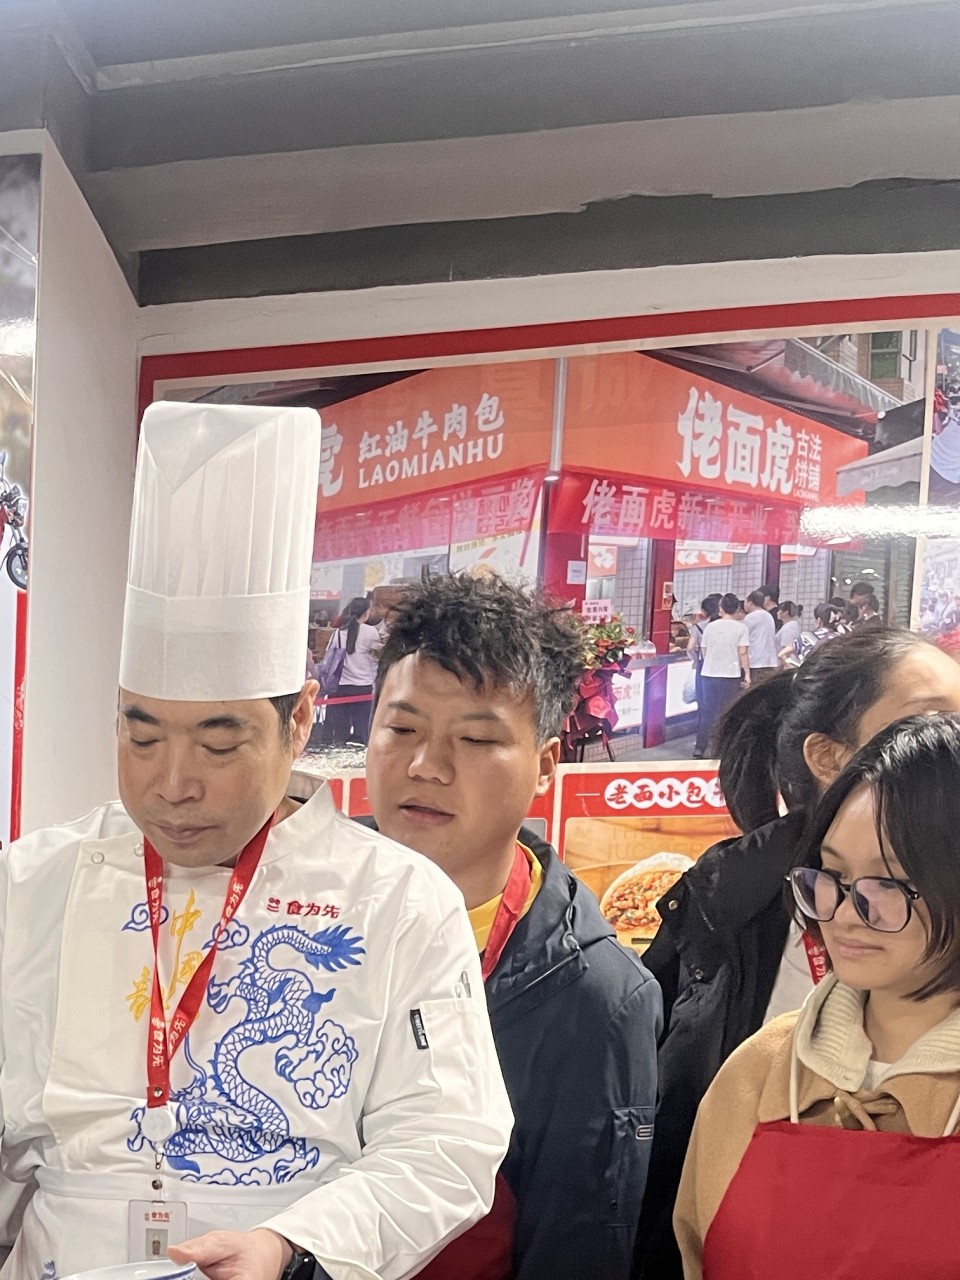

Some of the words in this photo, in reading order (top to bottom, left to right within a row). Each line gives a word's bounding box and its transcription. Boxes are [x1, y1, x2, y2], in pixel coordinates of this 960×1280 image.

[357, 392, 505, 463] 红油牛肉包
[675, 386, 794, 495] 佬面虎
[358, 432, 504, 489] LAOMIANHU
[287, 900, 341, 919] 食为先
